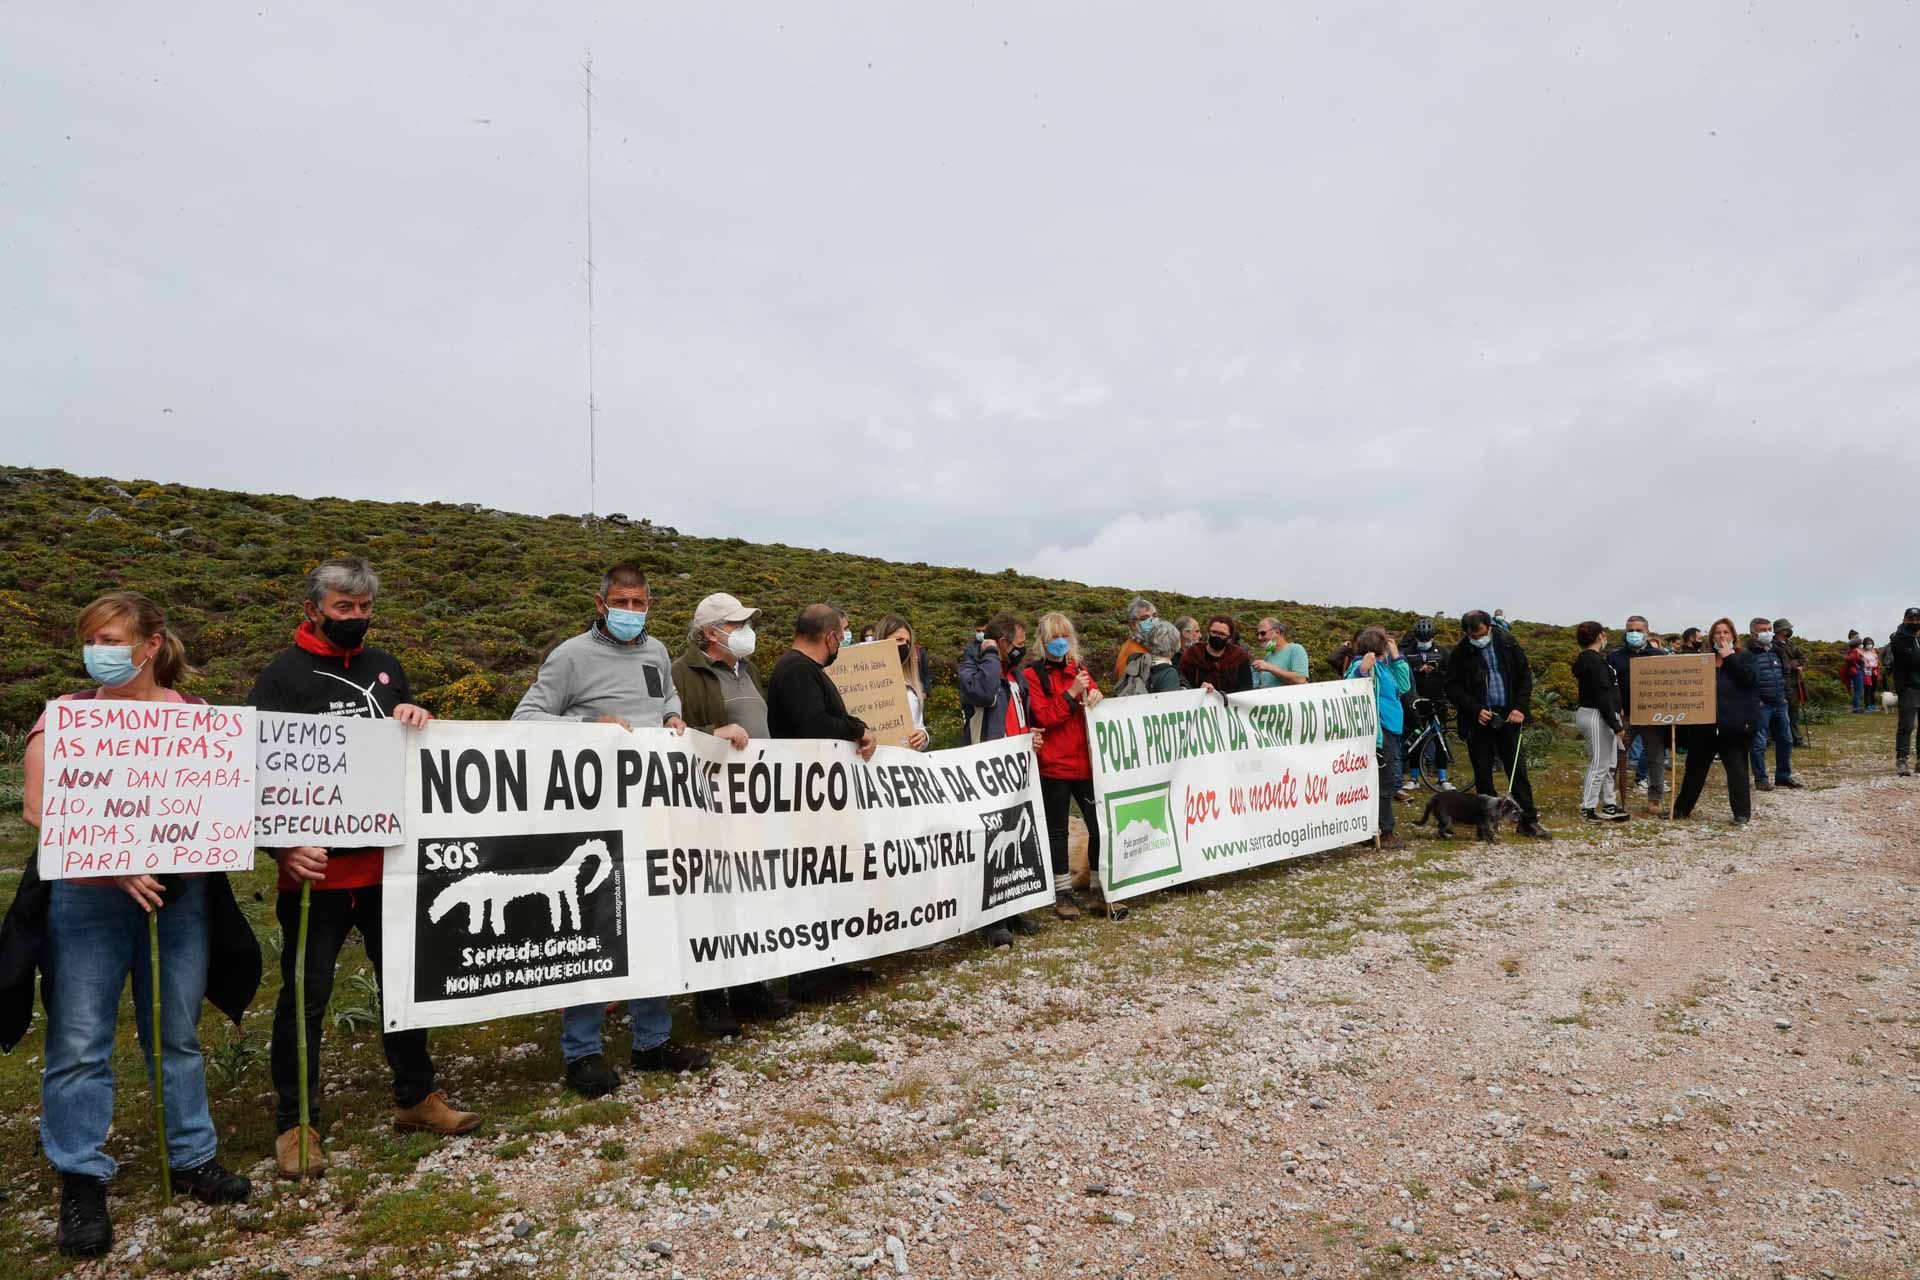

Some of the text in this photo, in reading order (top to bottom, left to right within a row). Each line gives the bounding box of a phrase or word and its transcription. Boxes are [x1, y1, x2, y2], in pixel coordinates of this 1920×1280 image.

[58, 706, 243, 737] DESMONTEMOS
[53, 735, 233, 762] AS MENTIRAS,
[1096, 717, 1140, 773] POLA
[1225, 705, 1249, 751] DA
[1249, 703, 1293, 748] SERRA
[1299, 701, 1318, 745] DO
[265, 751, 347, 774] GROBA
[1332, 749, 1369, 775] eólicos
[127, 768, 168, 788] DAN
[420, 748, 528, 814] NON
[544, 748, 602, 811] AO
[617, 749, 723, 816] PARQUE
[728, 749, 848, 814] EÓLICO
[876, 764, 945, 809] SERRA
[939, 765, 977, 802] DA
[104, 796, 150, 817] NON
[157, 795, 202, 816] SON
[1184, 767, 1329, 844] por un monte sen
[1335, 785, 1370, 806] minas
[150, 821, 200, 843] NON
[206, 820, 253, 842] SON
[983, 813, 1003, 831] SOS
[1201, 814, 1368, 861] www.serradogalinheiro.org
[65, 850, 131, 872] PARA
[145, 853, 159, 868] O
[425, 841, 480, 871] SOS
[646, 846, 732, 897] ESPAZO
[735, 845, 854, 892] NATURAL
[863, 842, 877, 880] E
[883, 829, 976, 878] CULTURAL
[614, 869, 622, 936] www.sosgroba.com
[689, 897, 957, 963] www.sosgroba.com
[461, 944, 516, 967] Serra
[517, 940, 540, 960] da
[445, 974, 479, 994] NON
[483, 973, 502, 988] AO
[505, 964, 562, 984] PARQUE
